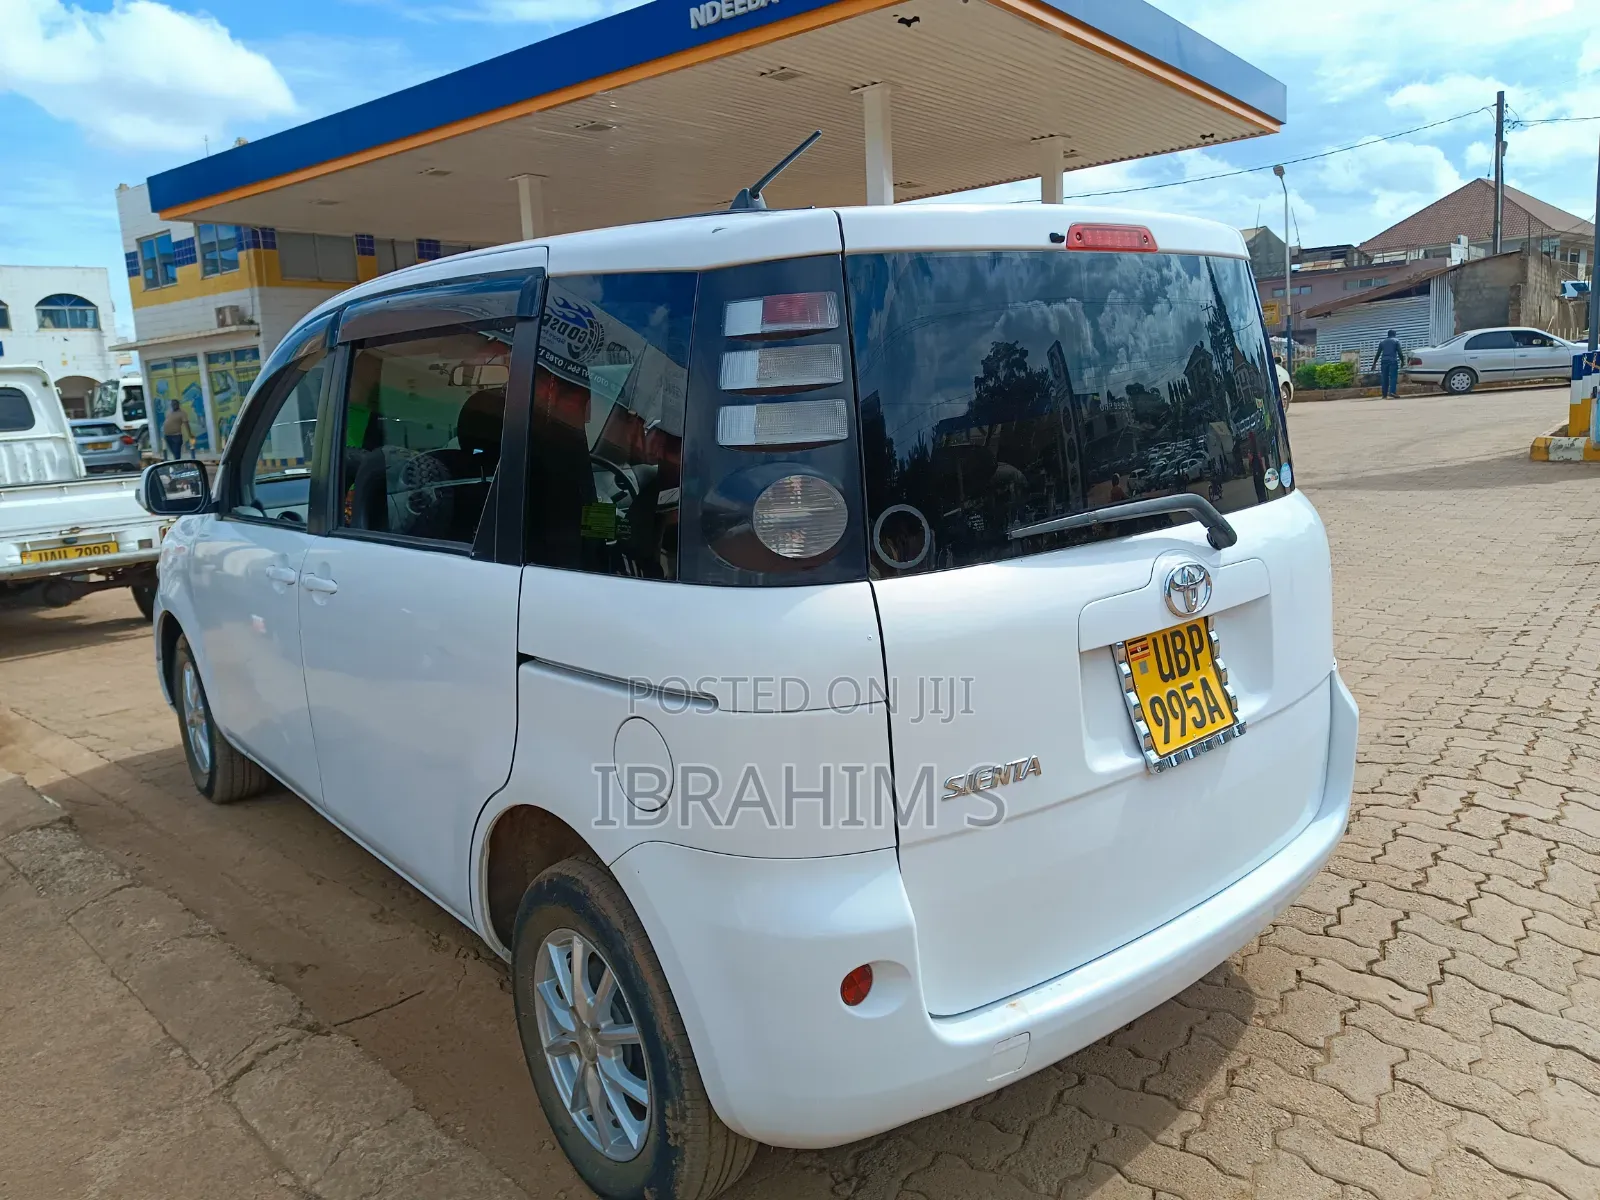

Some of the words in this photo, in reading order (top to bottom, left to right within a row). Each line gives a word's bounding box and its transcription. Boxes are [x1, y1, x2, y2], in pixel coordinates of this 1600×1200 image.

[1152, 623, 1204, 683] UBP
[1150, 677, 1225, 745] 995A
[940, 753, 1042, 802] SIENTA
